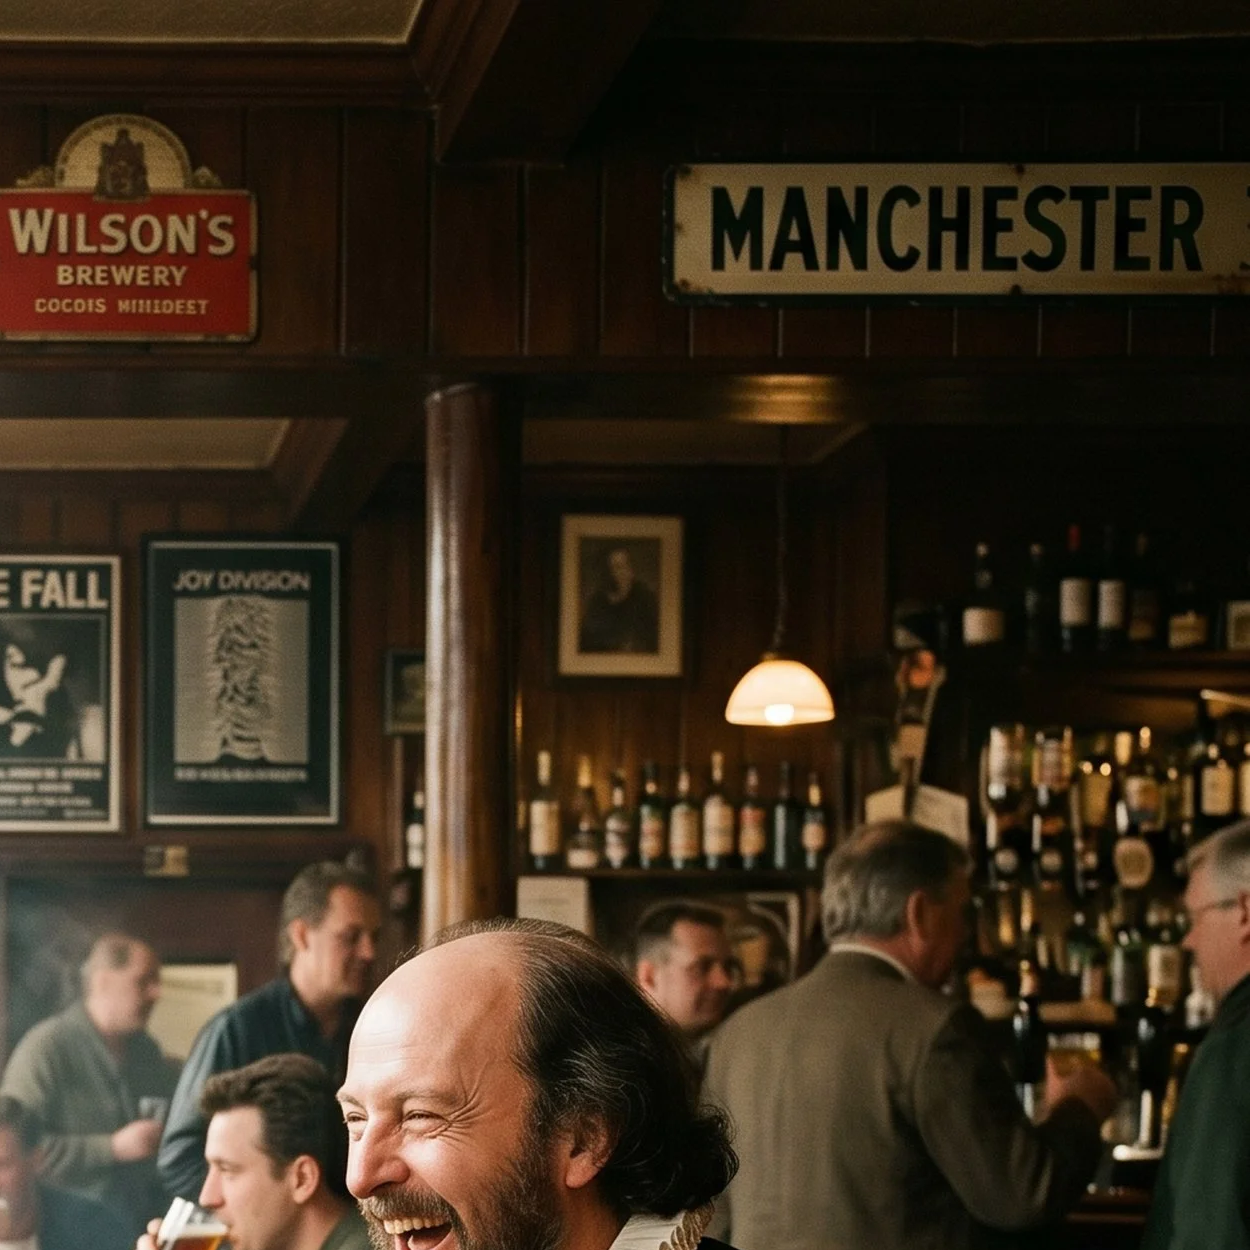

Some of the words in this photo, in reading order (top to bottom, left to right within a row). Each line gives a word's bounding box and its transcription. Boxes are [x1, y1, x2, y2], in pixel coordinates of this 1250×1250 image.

[8, 208, 235, 255] WILSON'S
[710, 185, 1204, 272] MANCHESTER
[56, 265, 187, 286] BREWERY
[21, 570, 108, 609] FALL
[174, 570, 215, 591] JOY
[218, 570, 311, 591] DIVISION
